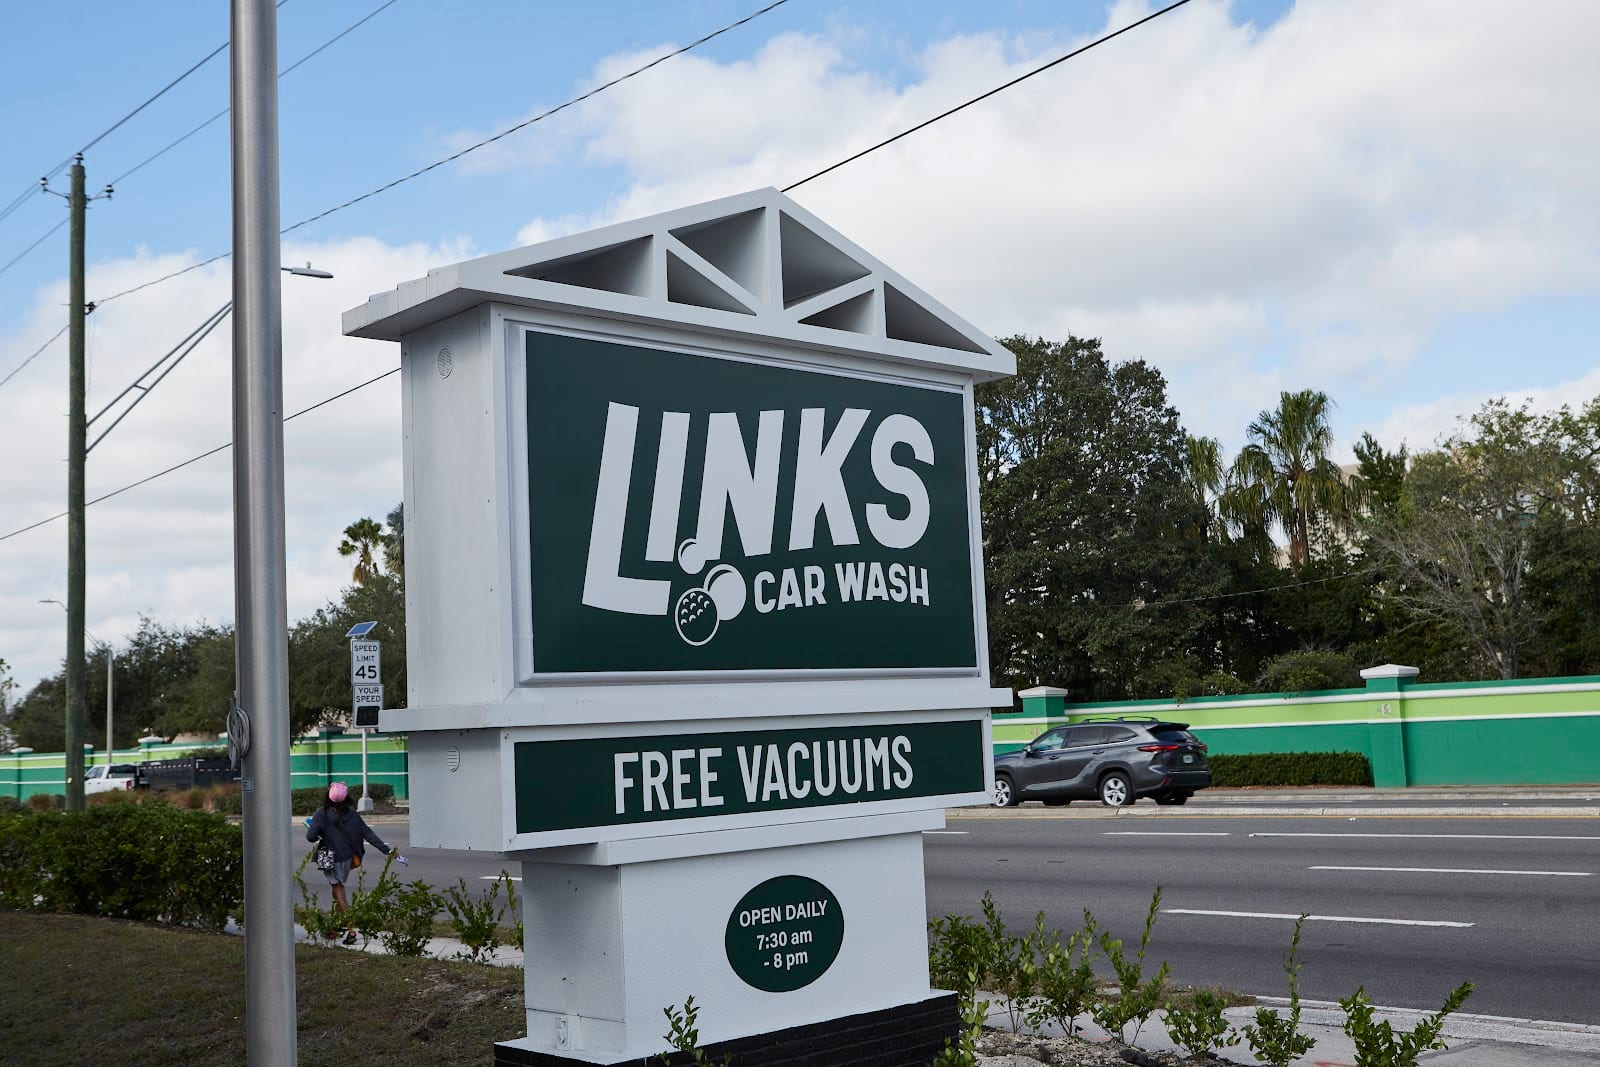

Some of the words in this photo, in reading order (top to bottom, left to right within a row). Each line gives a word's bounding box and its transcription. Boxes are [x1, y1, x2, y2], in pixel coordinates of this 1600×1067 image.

[582, 401, 935, 616] LINKS
[754, 564, 827, 614] CAR
[834, 561, 930, 607] WASH
[355, 666, 376, 678] 45
[614, 747, 725, 815] FREE
[736, 735, 914, 803] VACUUMS
[739, 905, 781, 928] OPEN
[785, 899, 828, 921] DAILY
[756, 930, 788, 950] 7:30
[791, 928, 813, 944] am
[773, 952, 783, 969] 8
[786, 949, 808, 971] pm
